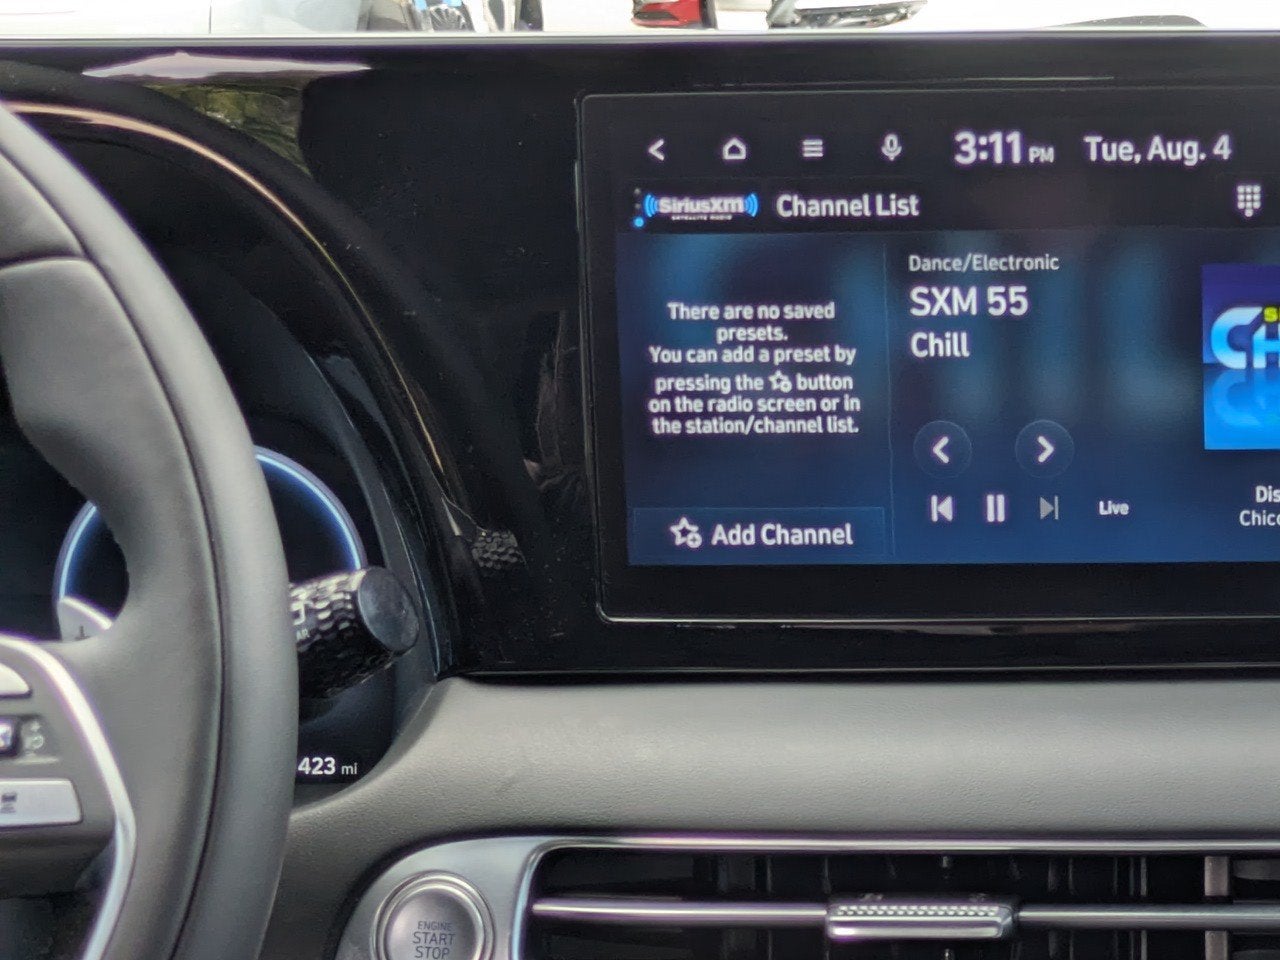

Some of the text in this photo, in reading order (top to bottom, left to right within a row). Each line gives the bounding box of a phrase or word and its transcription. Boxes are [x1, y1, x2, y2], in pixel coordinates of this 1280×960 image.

[954, 131, 1053, 164] 3:11 PM
[1084, 135, 1232, 165] Tue, Aug. 4
[776, 193, 919, 217] Channel List
[909, 253, 1059, 272] Dance/Electronic
[668, 301, 835, 320] There are no saved
[910, 285, 1029, 316] SXM 55
[716, 324, 788, 344] presets.
[911, 331, 970, 358] Chill
[649, 345, 856, 367] You can add a preset by
[655, 373, 853, 394] pressing the button
[648, 394, 860, 412] on the radio screen or in
[652, 415, 859, 435] the station/channel list.
[1099, 501, 1129, 515] Live
[712, 523, 853, 546] Add Channel
[298, 757, 357, 775] 423 mi
[418, 920, 452, 931] ENGINE
[412, 932, 456, 945] START
[415, 947, 450, 960] STOP
